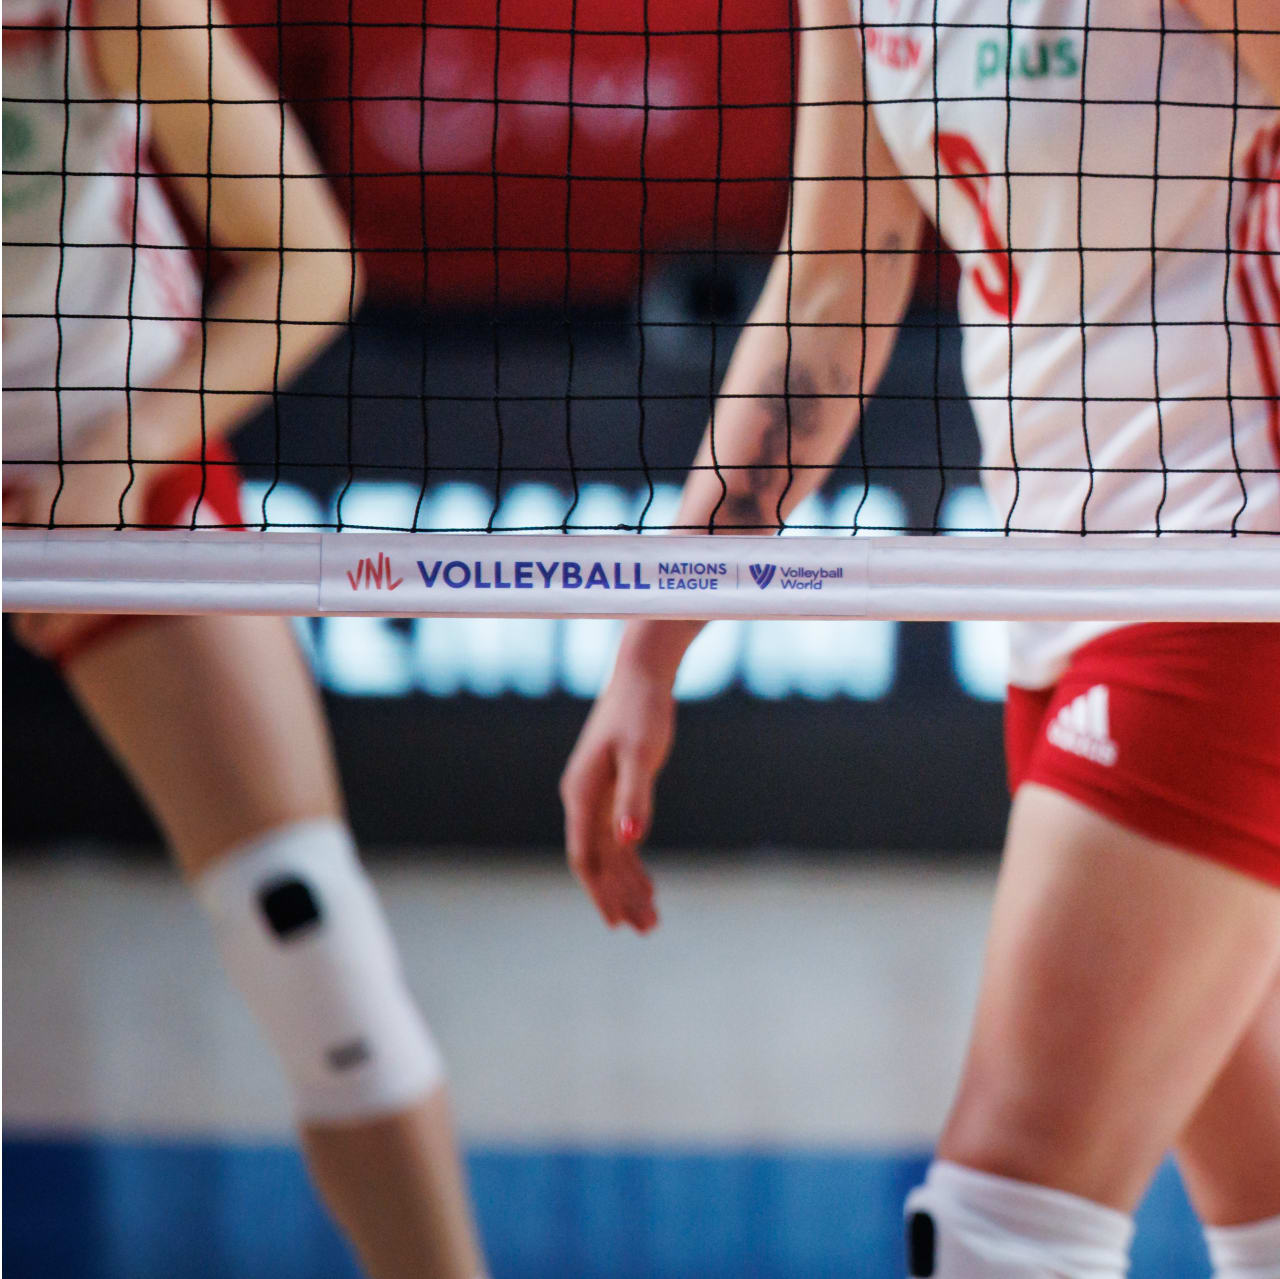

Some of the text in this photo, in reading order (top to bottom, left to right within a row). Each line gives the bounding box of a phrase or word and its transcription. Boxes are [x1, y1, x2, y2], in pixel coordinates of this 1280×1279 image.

[346, 551, 651, 591] VNL VOLLEYBALL
[658, 562, 727, 576] NATIONS
[780, 566, 843, 580] Volleyball
[658, 577, 718, 590] LEAGUE
[780, 579, 823, 590] World
